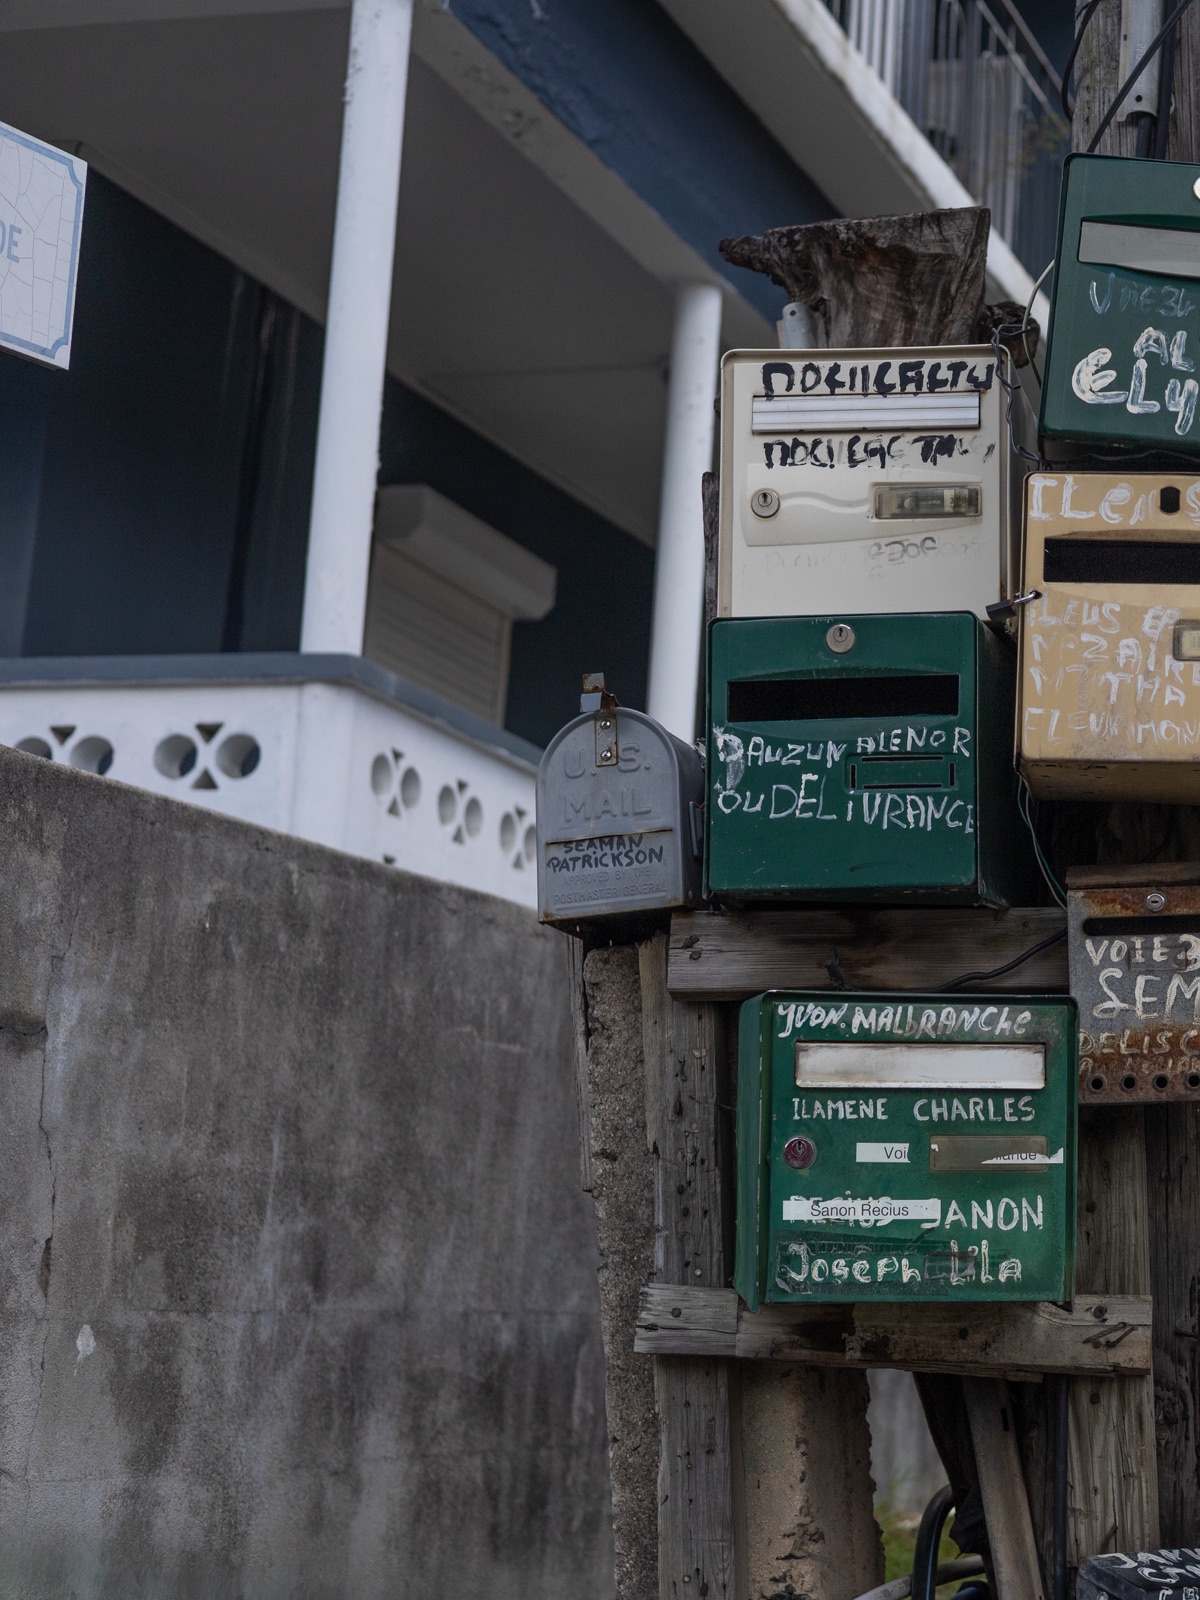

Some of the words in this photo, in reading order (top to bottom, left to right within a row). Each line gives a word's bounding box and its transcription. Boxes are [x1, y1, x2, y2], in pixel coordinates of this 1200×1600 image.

[563, 786, 653, 823] MAIL
[563, 834, 644, 854] SEAMAN
[563, 869, 610, 888] APPROVED
[615, 868, 627, 881] BY
[633, 866, 652, 879] THE
[554, 886, 619, 906] POSTMASTER
[622, 882, 668, 898] GENERAL
[1085, 936, 1169, 966] VOIE
[913, 1095, 1035, 1123] CHARLES
[810, 1204, 856, 1217] Sanon
[861, 1203, 909, 1217] Recius
